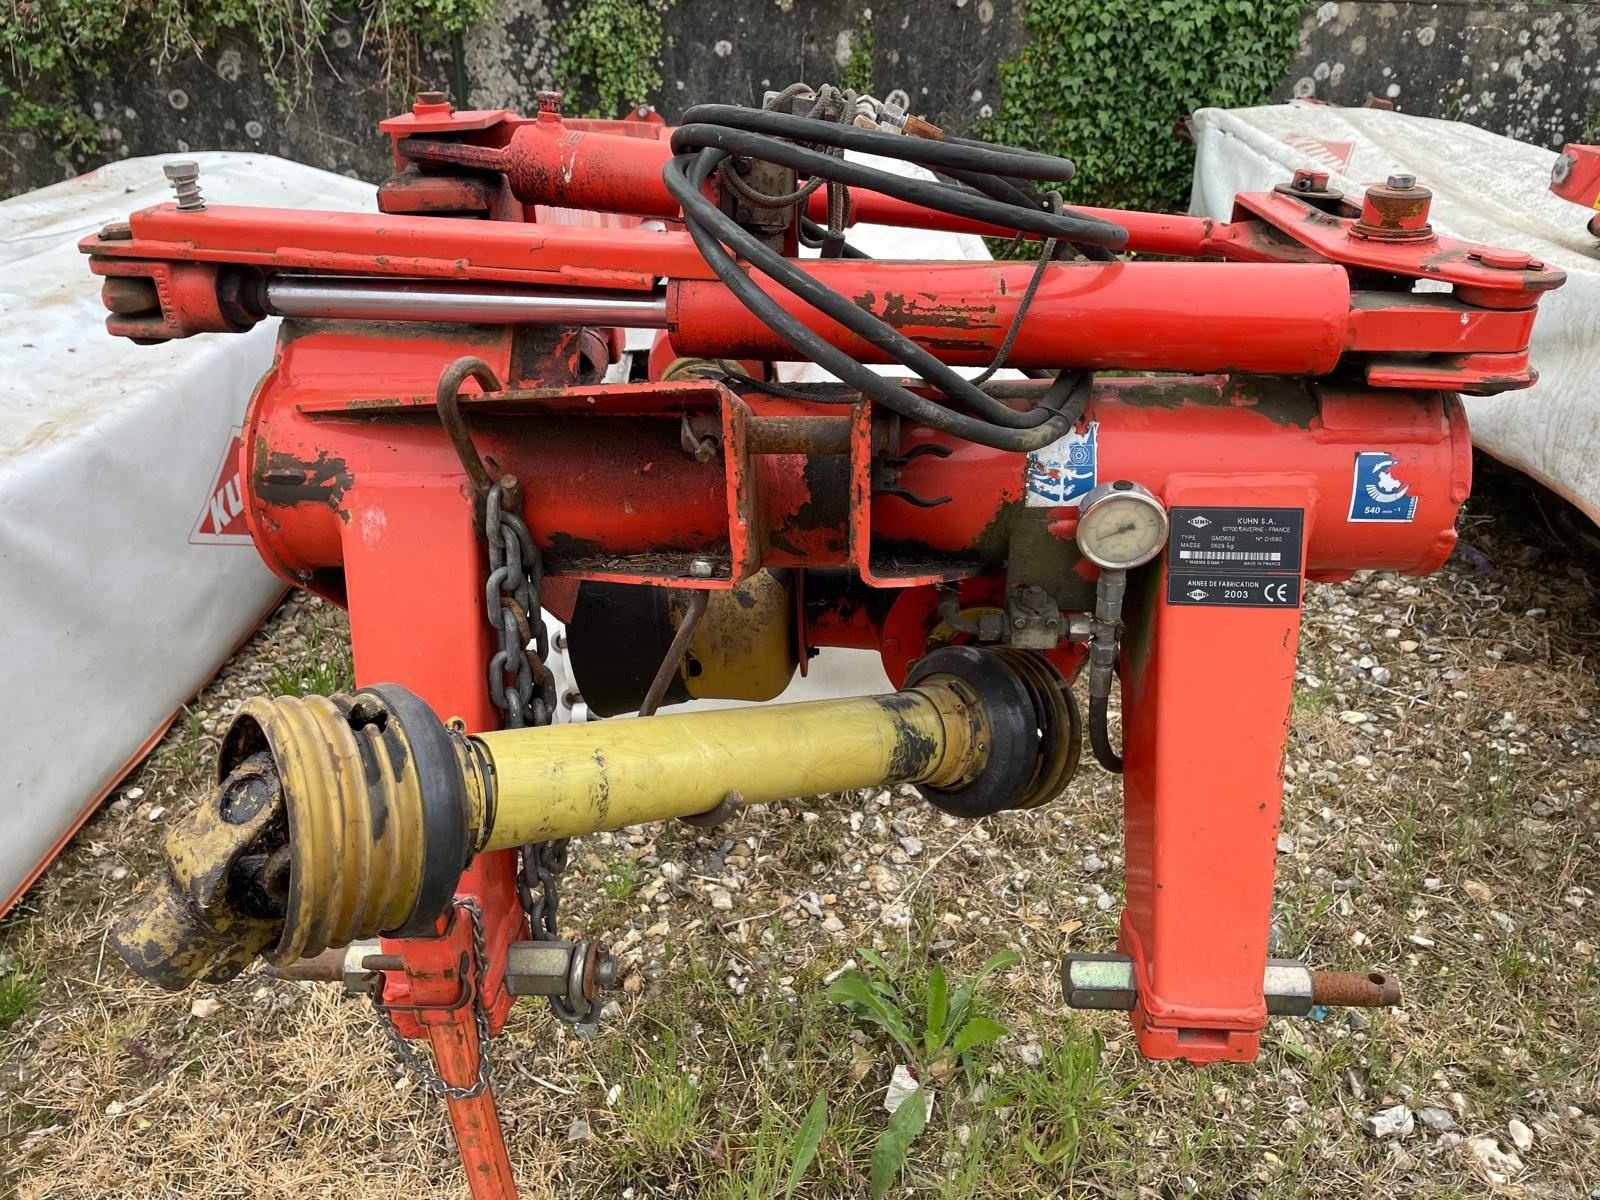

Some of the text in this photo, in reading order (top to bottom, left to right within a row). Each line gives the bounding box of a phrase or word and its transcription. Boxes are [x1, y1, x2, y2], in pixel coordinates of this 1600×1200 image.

[1364, 506, 1381, 514] 540
[1226, 542, 1235, 550] kg
[1218, 580, 1260, 588] FABRICATION
[1224, 590, 1249, 599] 2003
[1264, 583, 1288, 602] CE
